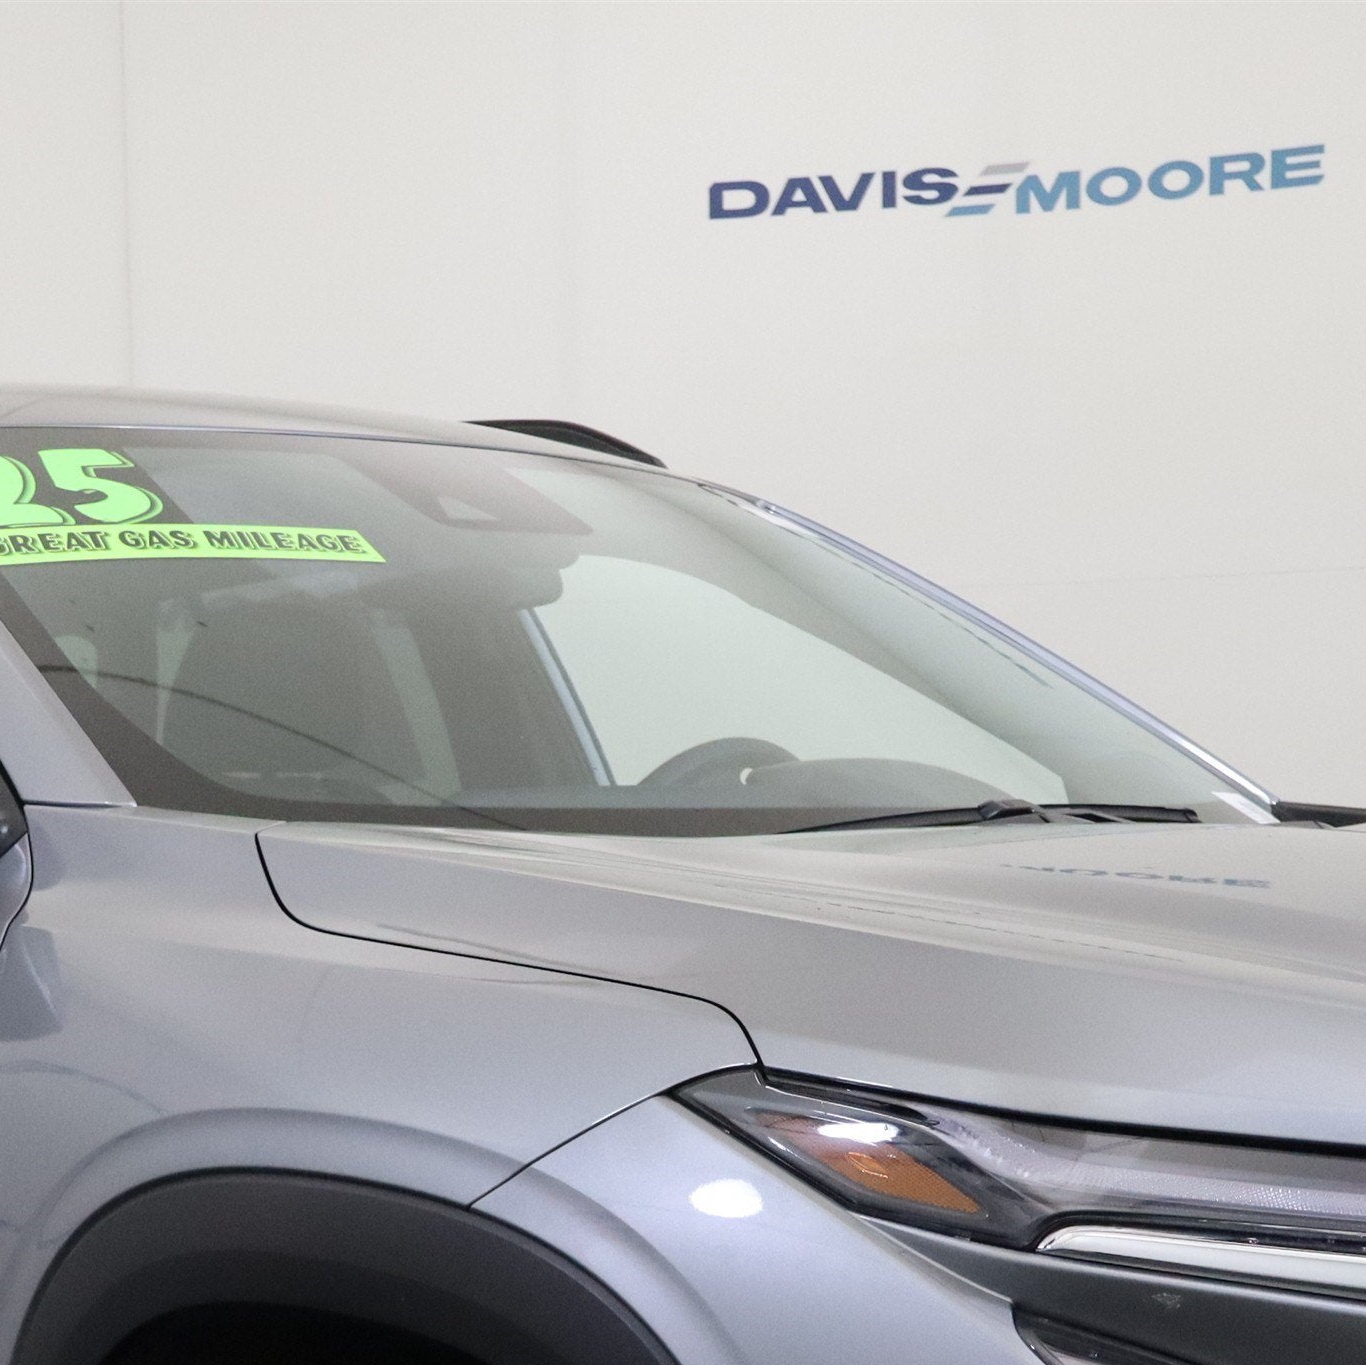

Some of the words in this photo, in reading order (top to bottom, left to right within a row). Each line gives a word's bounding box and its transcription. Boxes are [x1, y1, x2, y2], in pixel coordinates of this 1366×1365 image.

[709, 168, 958, 220] DAVIS
[1015, 144, 1325, 214] MOORE
[119, 529, 197, 551] GAS
[206, 529, 366, 554] MILEAGE
